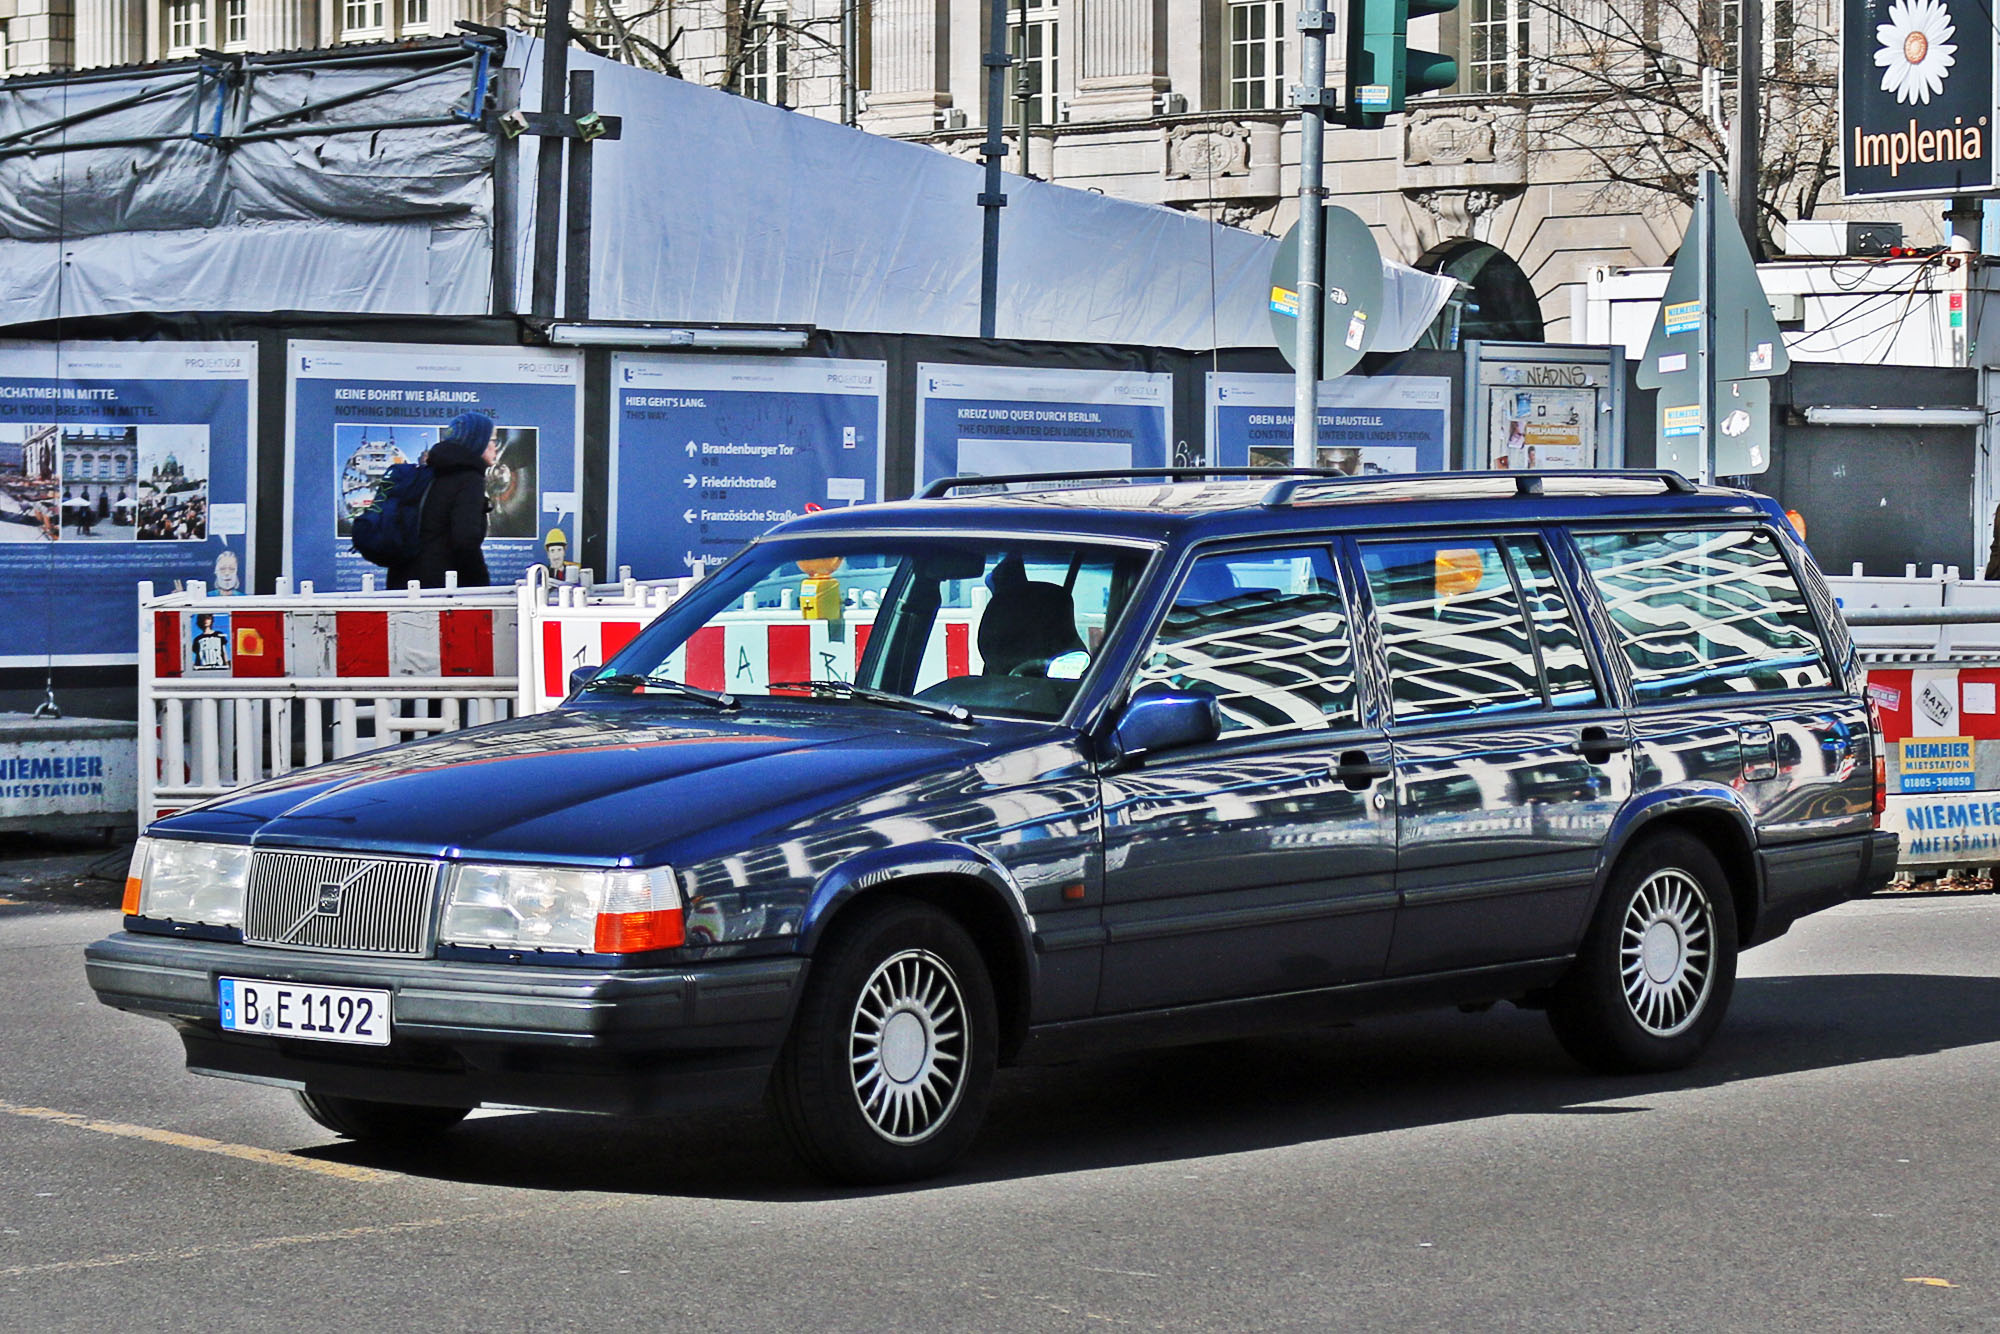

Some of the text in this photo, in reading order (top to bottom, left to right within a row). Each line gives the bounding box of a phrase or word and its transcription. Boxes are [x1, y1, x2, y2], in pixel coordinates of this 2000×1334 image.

[1854, 116, 1982, 177] Implenia
[62, 388, 76, 400] IN
[77, 388, 119, 400] MITTE.
[335, 389, 366, 400] KEINE
[367, 390, 403, 401] BOHRT
[405, 391, 425, 401] WIE
[625, 396, 647, 407] HIER
[679, 398, 707, 408] LANG.
[20, 404, 55, 417] YOUR
[335, 405, 383, 417] NOTHING
[385, 406, 421, 418] DRILLS
[423, 408, 445, 418] LIKE
[626, 410, 645, 420] THIS
[957, 408, 1102, 423] KREUZ UND QUER DURCH BERLIN.
[1249, 415, 1274, 425] OBEN
[1276, 415, 1295, 425] BAH
[1335, 416, 1384, 426] BAUSTELLE.
[958, 424, 975, 434] THE
[976, 424, 1011, 435] FUTURE
[1012, 425, 1041, 436] UNTER
[1042, 427, 1061, 437] DEN
[1062, 427, 1095, 438] LINDEN
[1318, 430, 1347, 440] UNTER
[1349, 431, 1365, 440] DEN
[702, 442, 795, 458] Brandenburger Tor
[701, 475, 777, 489] Friedrichstraße
[701, 509, 798, 522] Französische Straße
[1923, 688, 1949, 719] RATH
[1905, 743, 1970, 758] NIEMEIER
[1905, 760, 1970, 770] MIETSTATION
[1904, 776, 1971, 788] 01805-308050
[225, 1008, 232, 1020] D
[244, 988, 373, 1036] B E 1192
